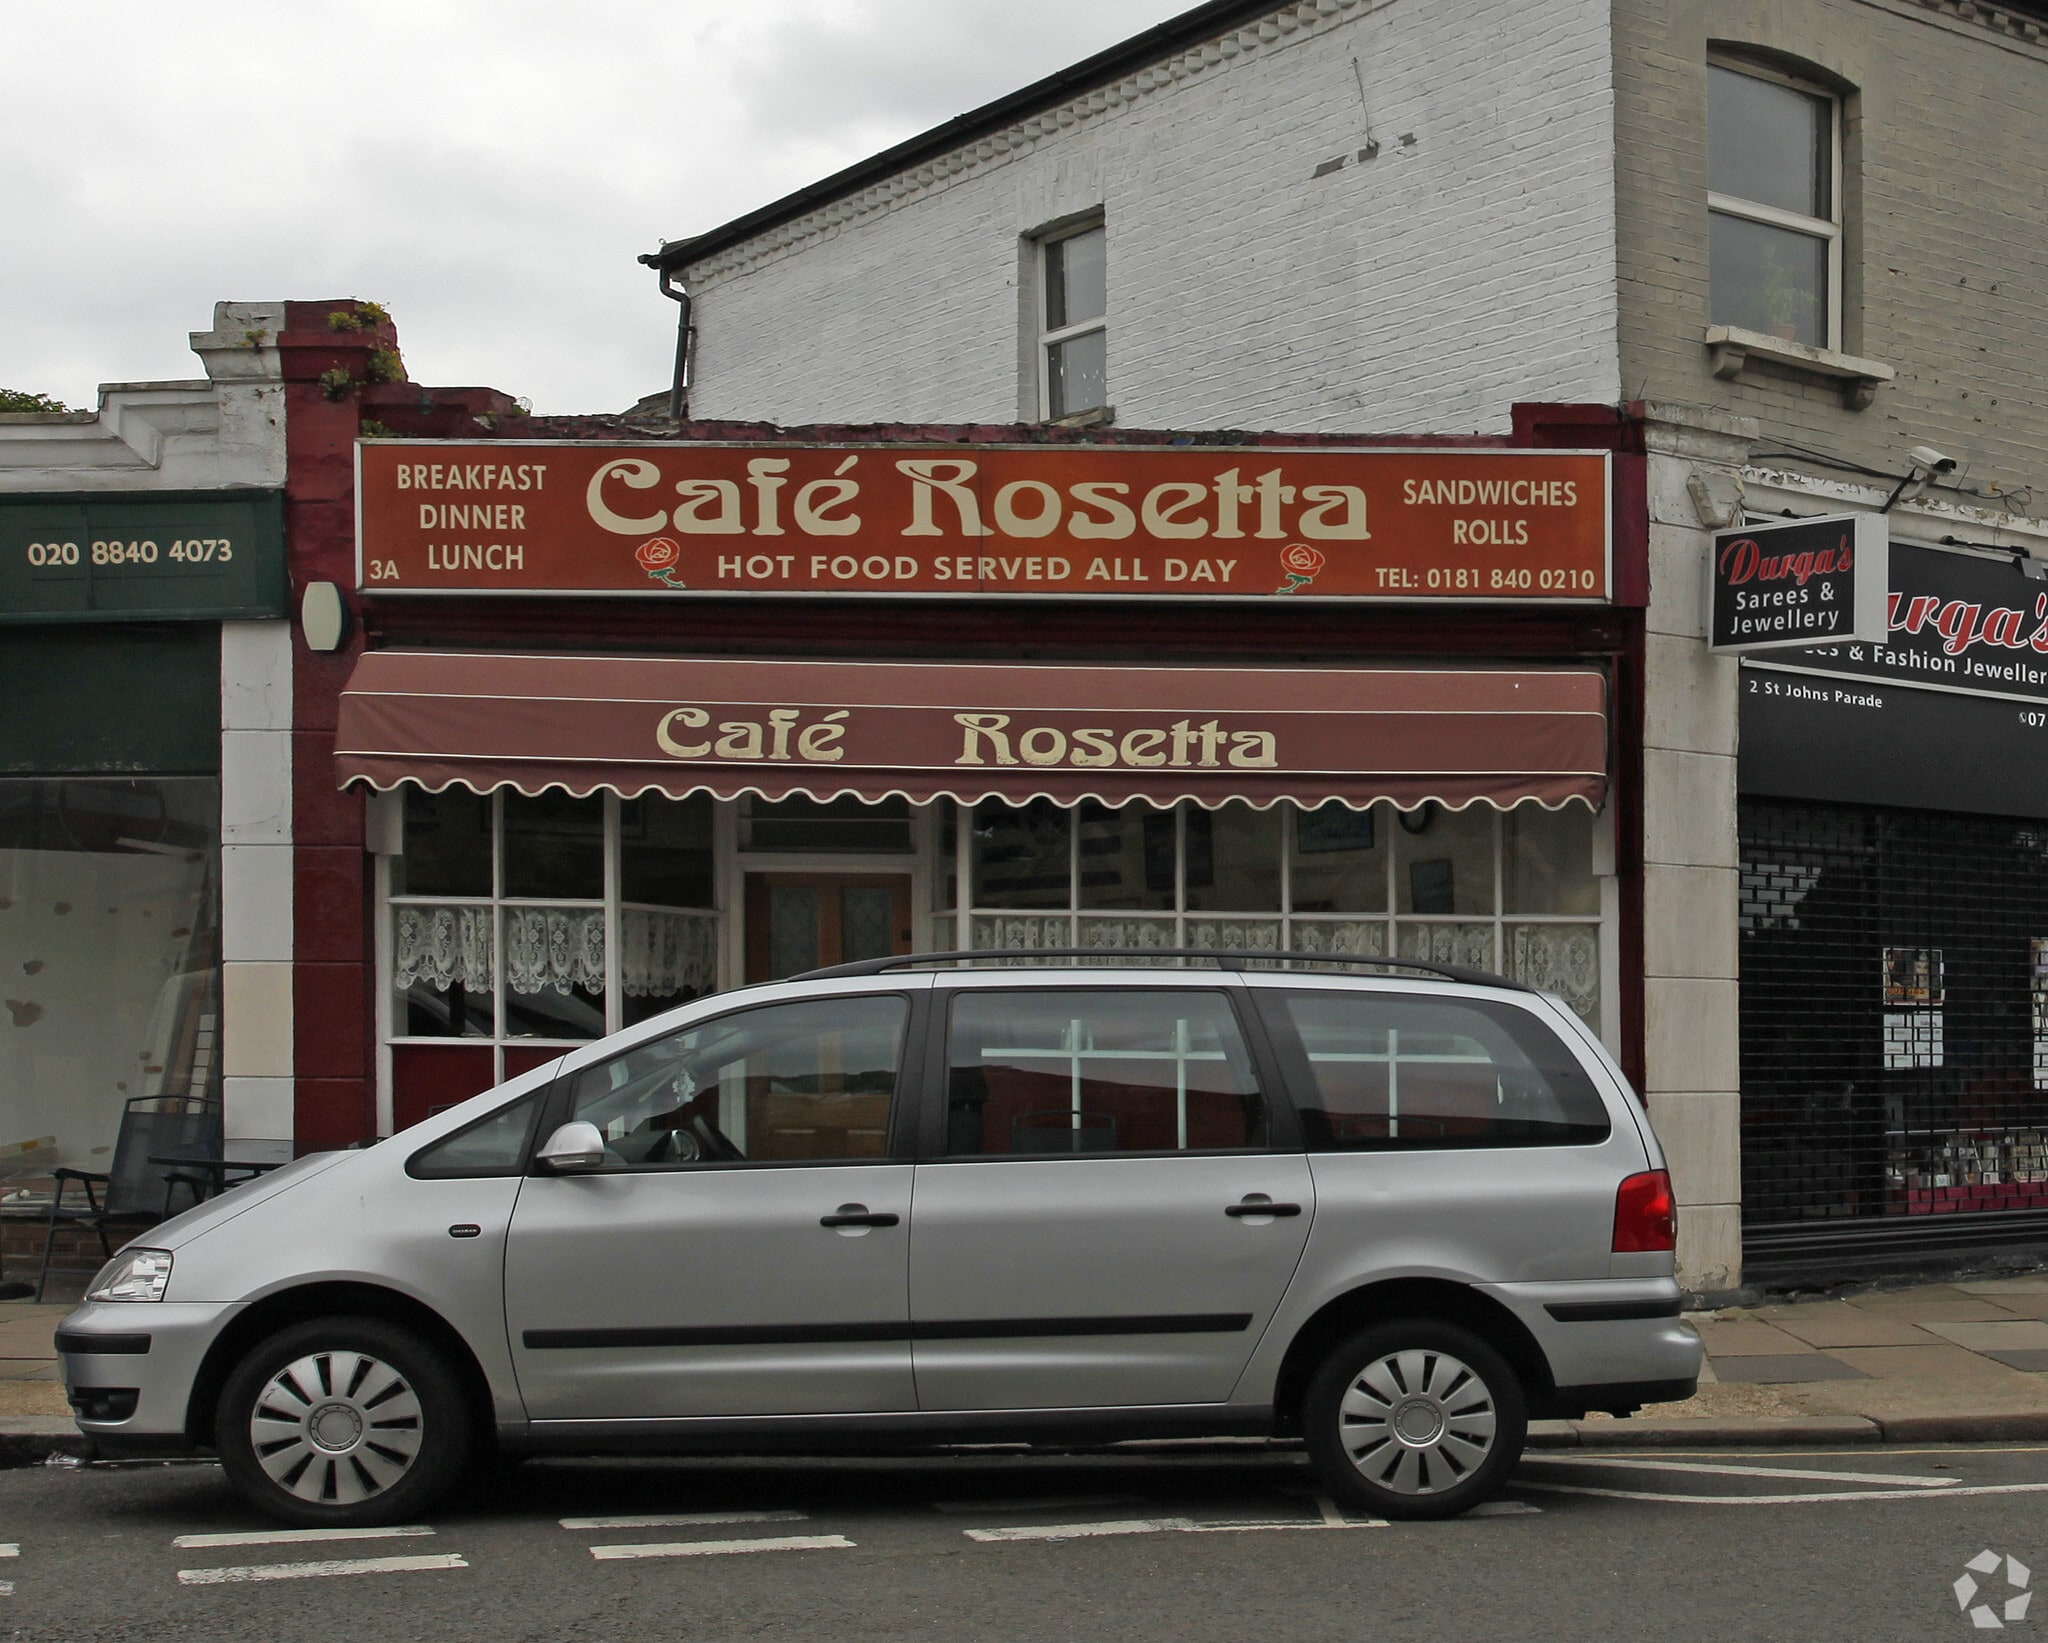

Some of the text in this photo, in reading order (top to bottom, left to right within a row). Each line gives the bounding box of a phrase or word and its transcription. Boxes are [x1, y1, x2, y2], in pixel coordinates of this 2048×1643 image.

[396, 465, 547, 490] BREAKFAST
[587, 455, 1371, 540] Café Rosetta
[1403, 480, 1577, 506] SANDWICHES
[420, 505, 526, 529] DINNER
[1453, 520, 1528, 544] ROLLS
[28, 539, 233, 566] 020 8840 4073
[428, 544, 524, 570] LUNCH
[1720, 534, 1853, 586] Durga's
[370, 559, 400, 580] 3A
[718, 556, 1237, 582] HOT FOOD SERVED ALL DAY
[1375, 568, 1595, 590] TEL: 0181 840 0210
[1736, 581, 1835, 610] Sarees &
[1730, 608, 1840, 635] Jewellery
[1873, 645, 1956, 673] Fashion
[1749, 680, 1883, 708] 2 St Johns Parade
[656, 707, 1277, 768] Café Rosetta
